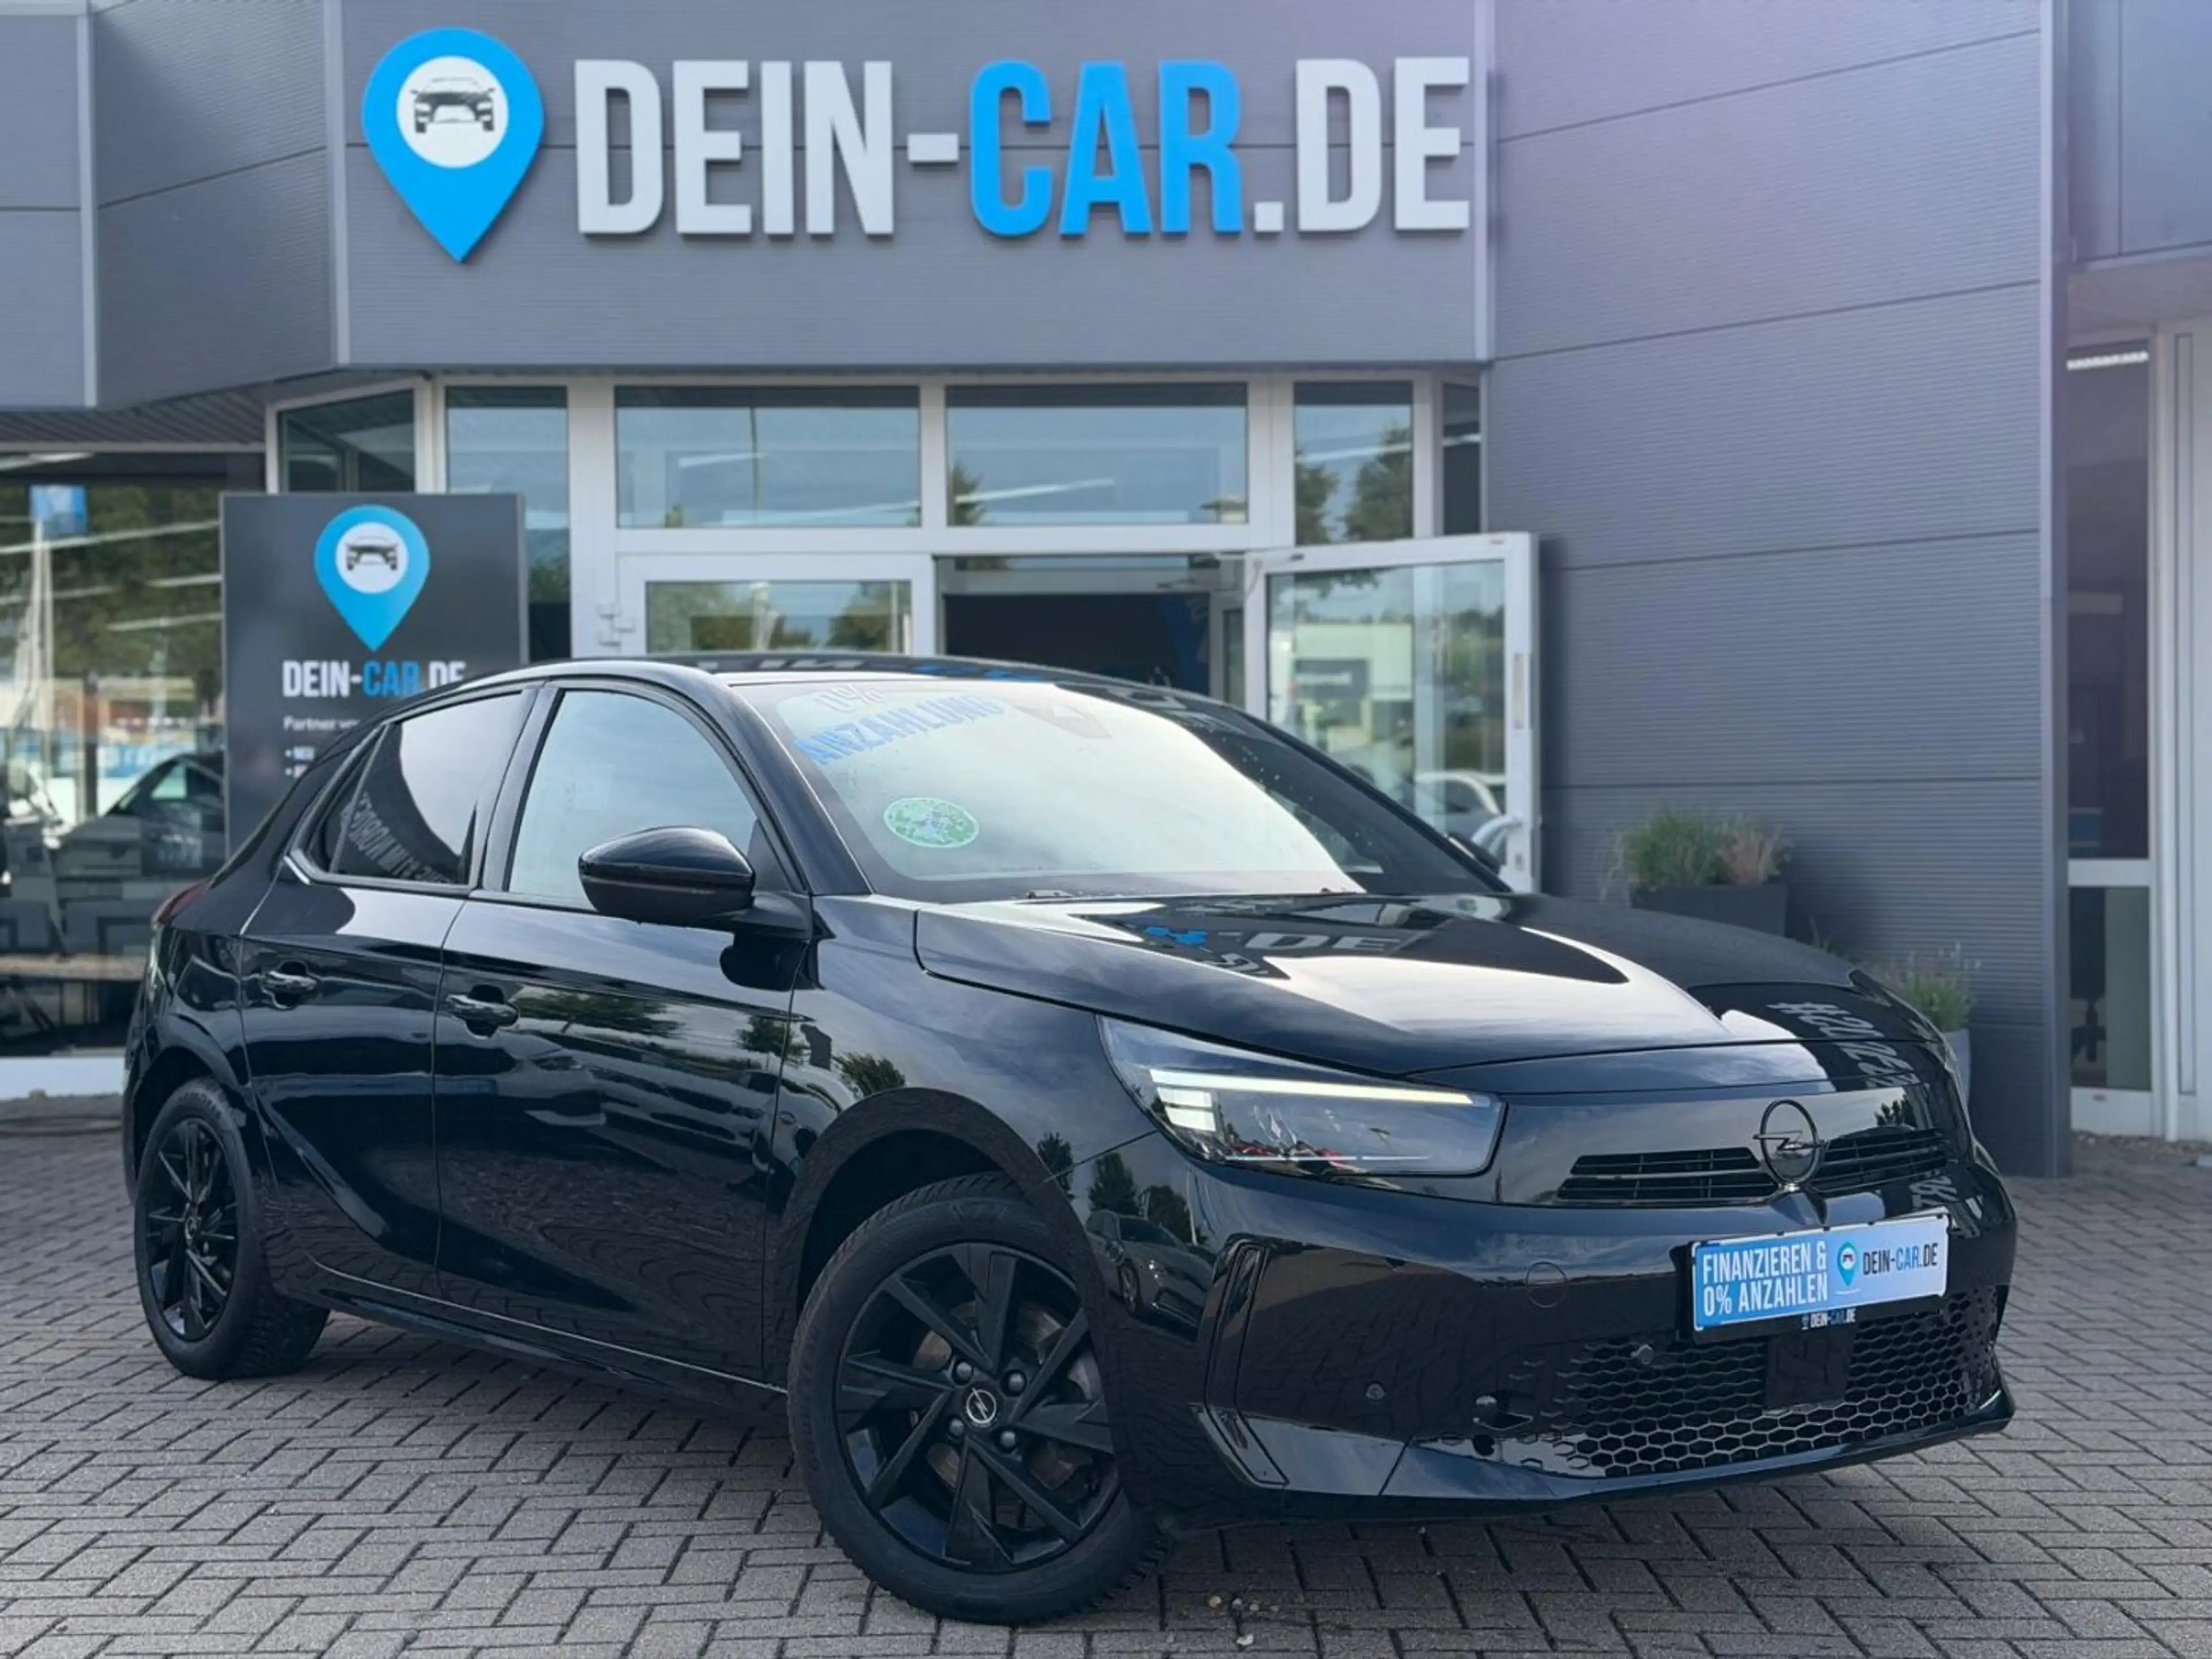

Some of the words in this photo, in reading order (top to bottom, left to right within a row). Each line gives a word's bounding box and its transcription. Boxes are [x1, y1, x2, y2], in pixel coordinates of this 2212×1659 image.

[575, 57, 1470, 237] DEIN-CAR.DE
[282, 660, 466, 697] DEIN-CARDE
[1702, 1242, 1812, 1285] FINANZIEREN
[1816, 1240, 1827, 1271] &
[1862, 1242, 1939, 1276] DEIN-CAR.DE
[1703, 1284, 1733, 1317] 0%
[1738, 1271, 1828, 1313] ANZAHLEN
